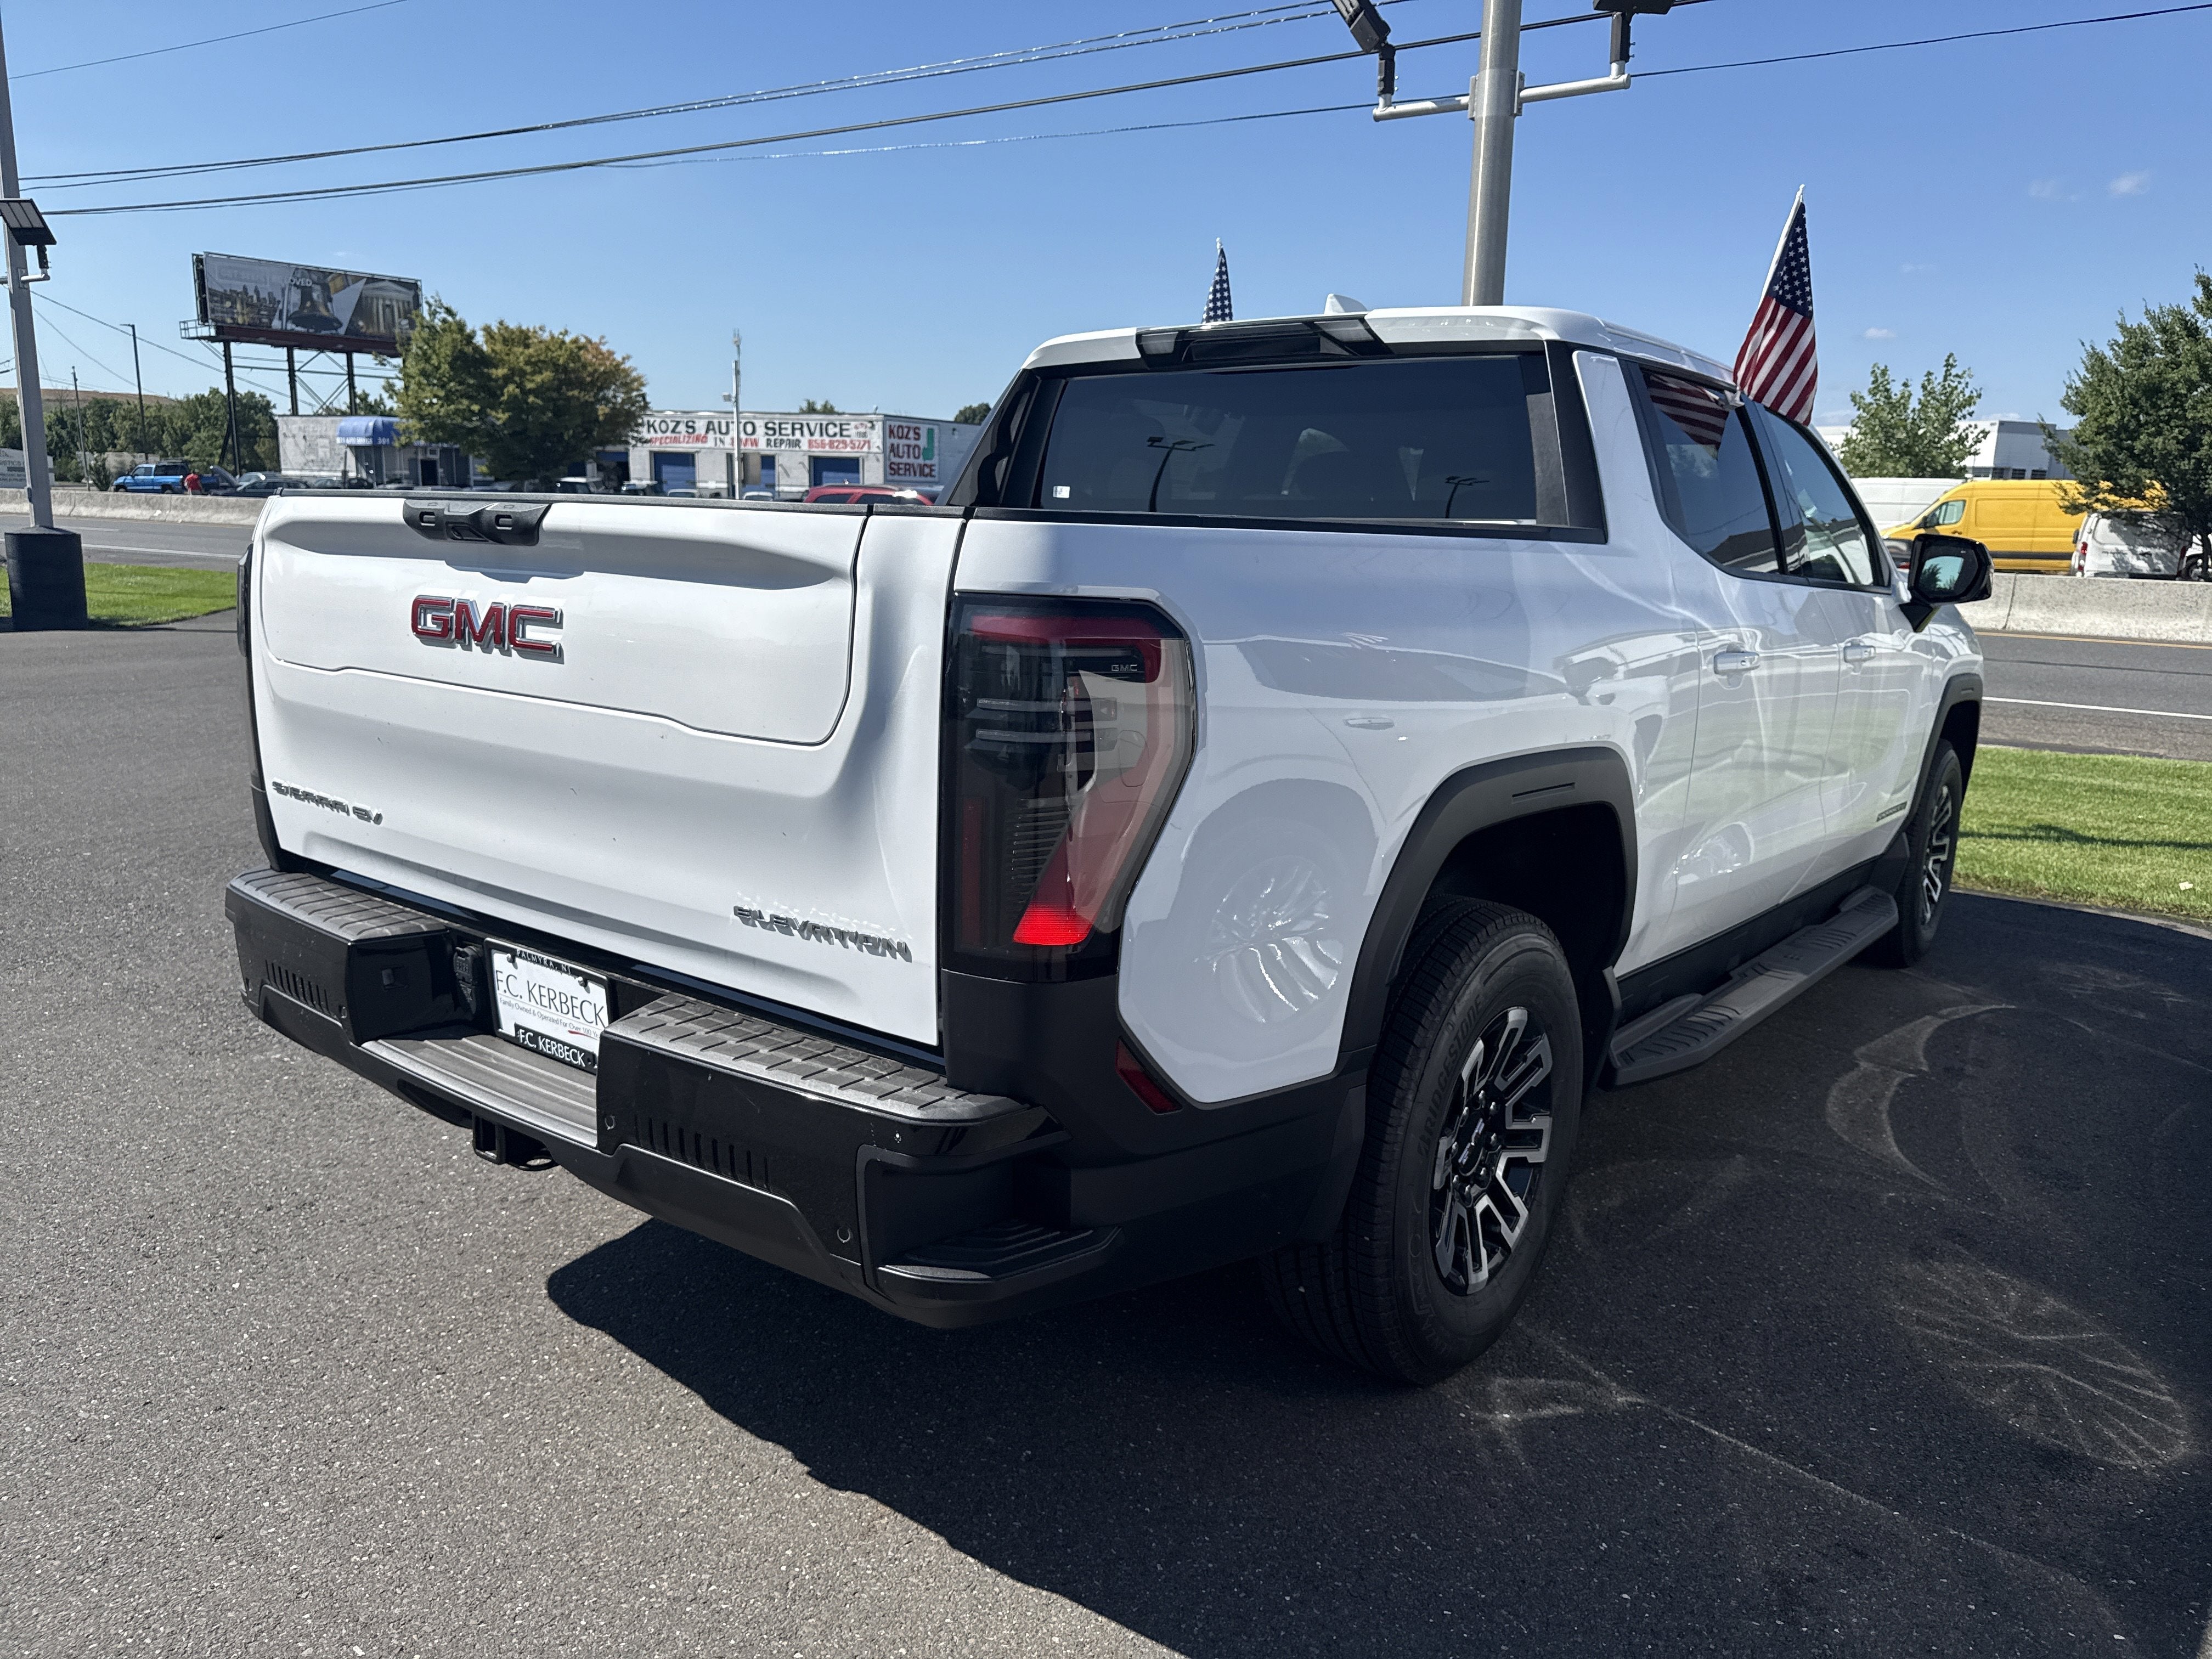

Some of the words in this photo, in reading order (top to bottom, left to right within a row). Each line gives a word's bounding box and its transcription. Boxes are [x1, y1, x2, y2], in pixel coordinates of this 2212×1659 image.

[647, 419, 697, 434] KOZ'S
[764, 421, 852, 438] SERVICE
[714, 437, 725, 447] IN
[766, 438, 802, 449] REPAIR
[889, 443, 922, 460] AUTO
[889, 461, 936, 478] SERVICE
[411, 594, 564, 658] GMC
[1111, 664, 1138, 672] GMC
[733, 905, 913, 963] ELEVATION
[516, 949, 558, 970] PALMYRA,
[561, 964, 571, 975] NJ
[495, 970, 523, 999] F.C.
[527, 980, 606, 1029] KERBECK
[499, 997, 515, 1009] Family
[515, 1002, 532, 1014] Owned
[537, 1011, 559, 1025] Operated
[560, 1019, 568, 1028] For
[569, 1022, 581, 1032] Over
[583, 1026, 592, 1036] 100
[518, 1029, 537, 1049] F.C.
[538, 1035, 586, 1068] KERBECK
